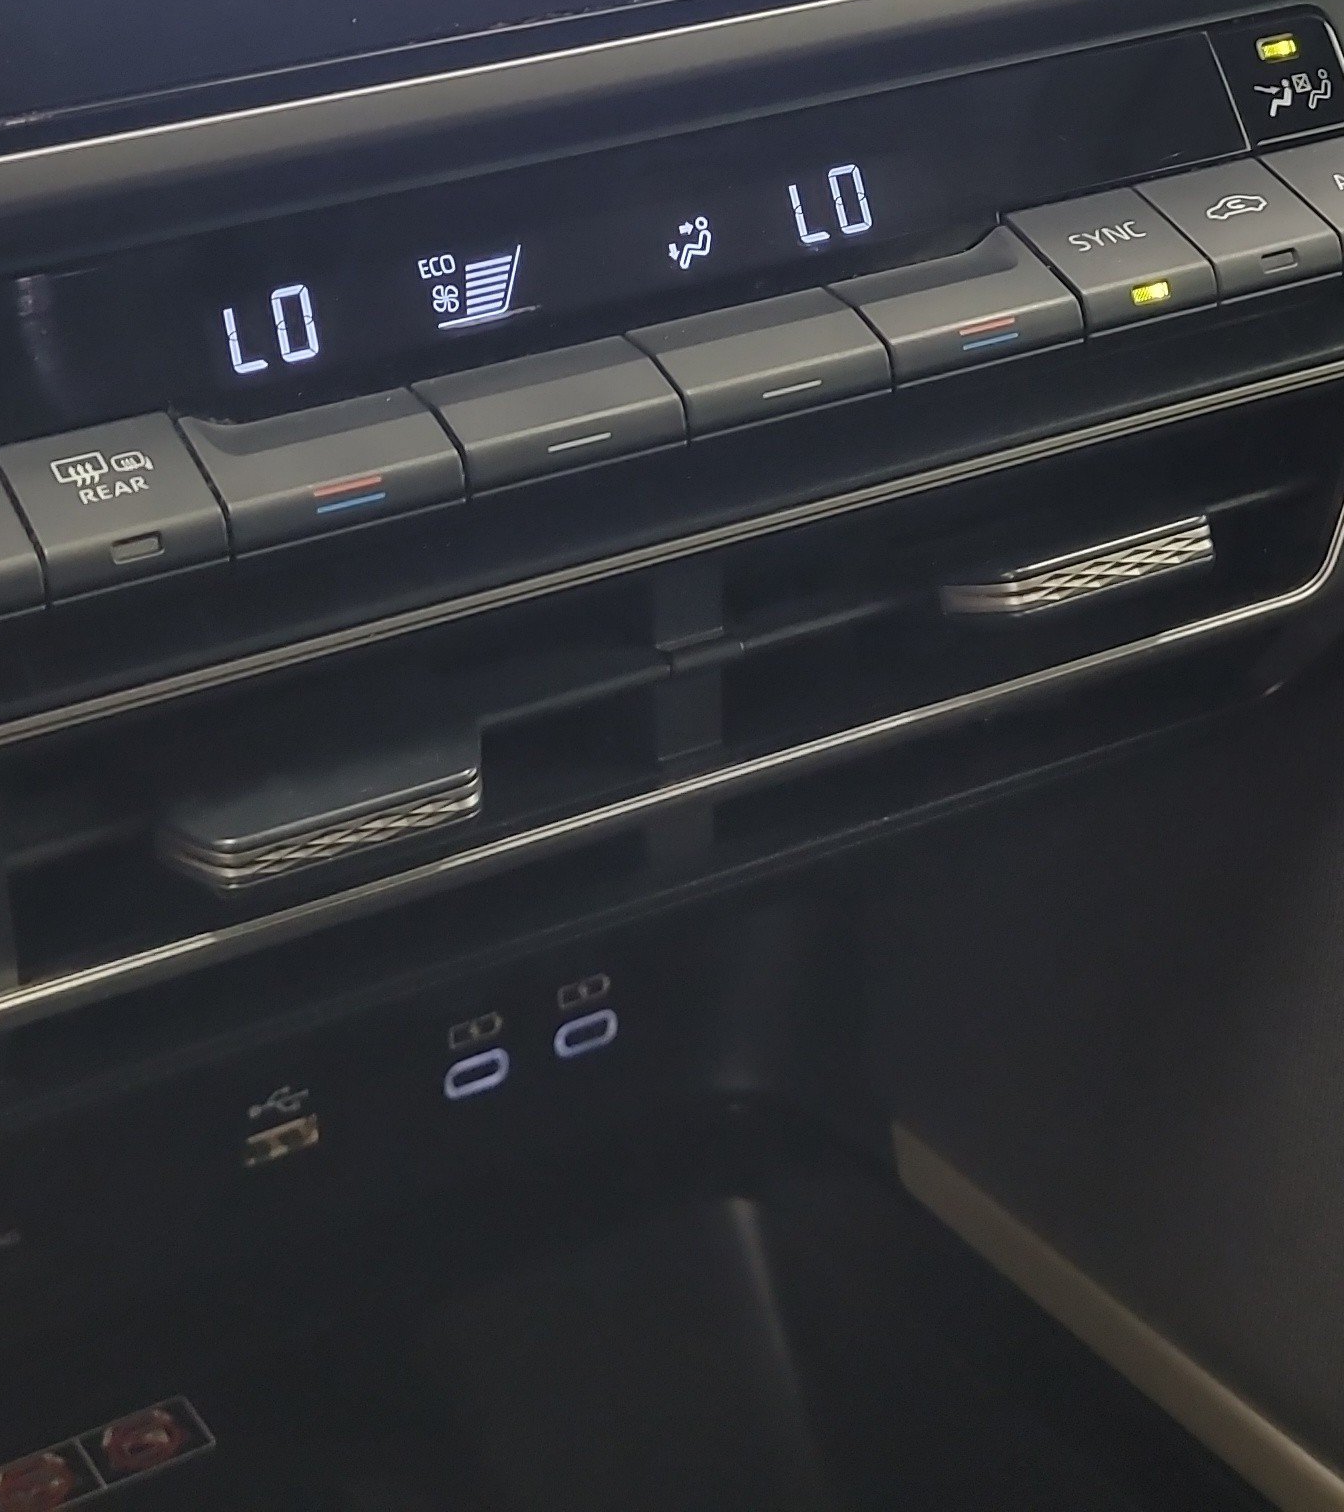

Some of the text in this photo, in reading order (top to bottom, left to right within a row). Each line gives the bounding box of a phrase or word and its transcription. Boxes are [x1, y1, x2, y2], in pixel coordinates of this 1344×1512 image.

[1068, 219, 1147, 253] SYNC
[417, 253, 457, 280] ECO
[78, 475, 150, 506] REAR
